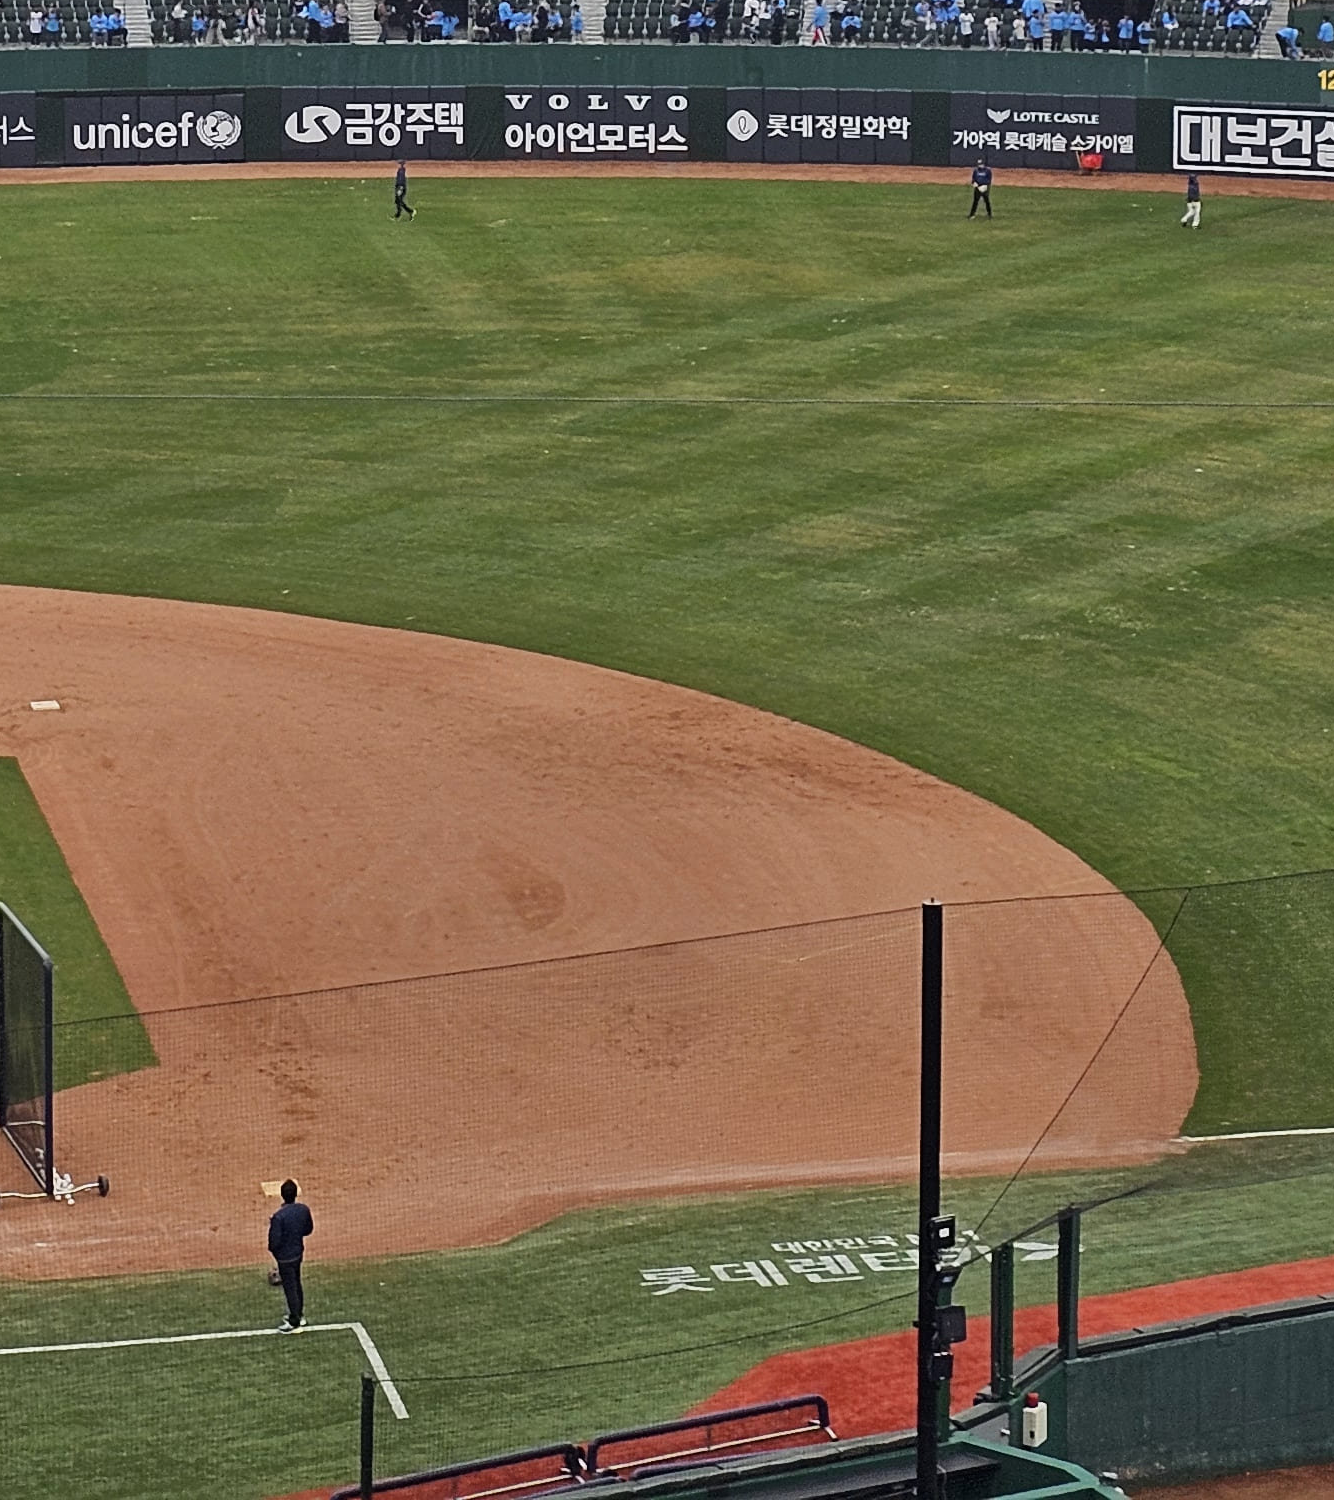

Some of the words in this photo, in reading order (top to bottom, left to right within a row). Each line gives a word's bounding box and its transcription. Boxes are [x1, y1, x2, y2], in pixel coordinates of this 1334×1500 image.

[505, 94, 688, 111] VOLVO
[73, 111, 194, 152] unicef
[344, 102, 465, 146] 금강주택
[767, 112, 911, 142] 롯데정밀화학
[1013, 112, 1052, 123] LOTTE
[1053, 112, 1100, 125] CASTLE
[505, 121, 688, 154] 아이언모터스
[953, 130, 1000, 149] 가야역
[1004, 132, 1067, 152] 롯데캐슬
[1069, 134, 1134, 154] 스카이엘
[771, 1235, 899, 1254] 대한민국
